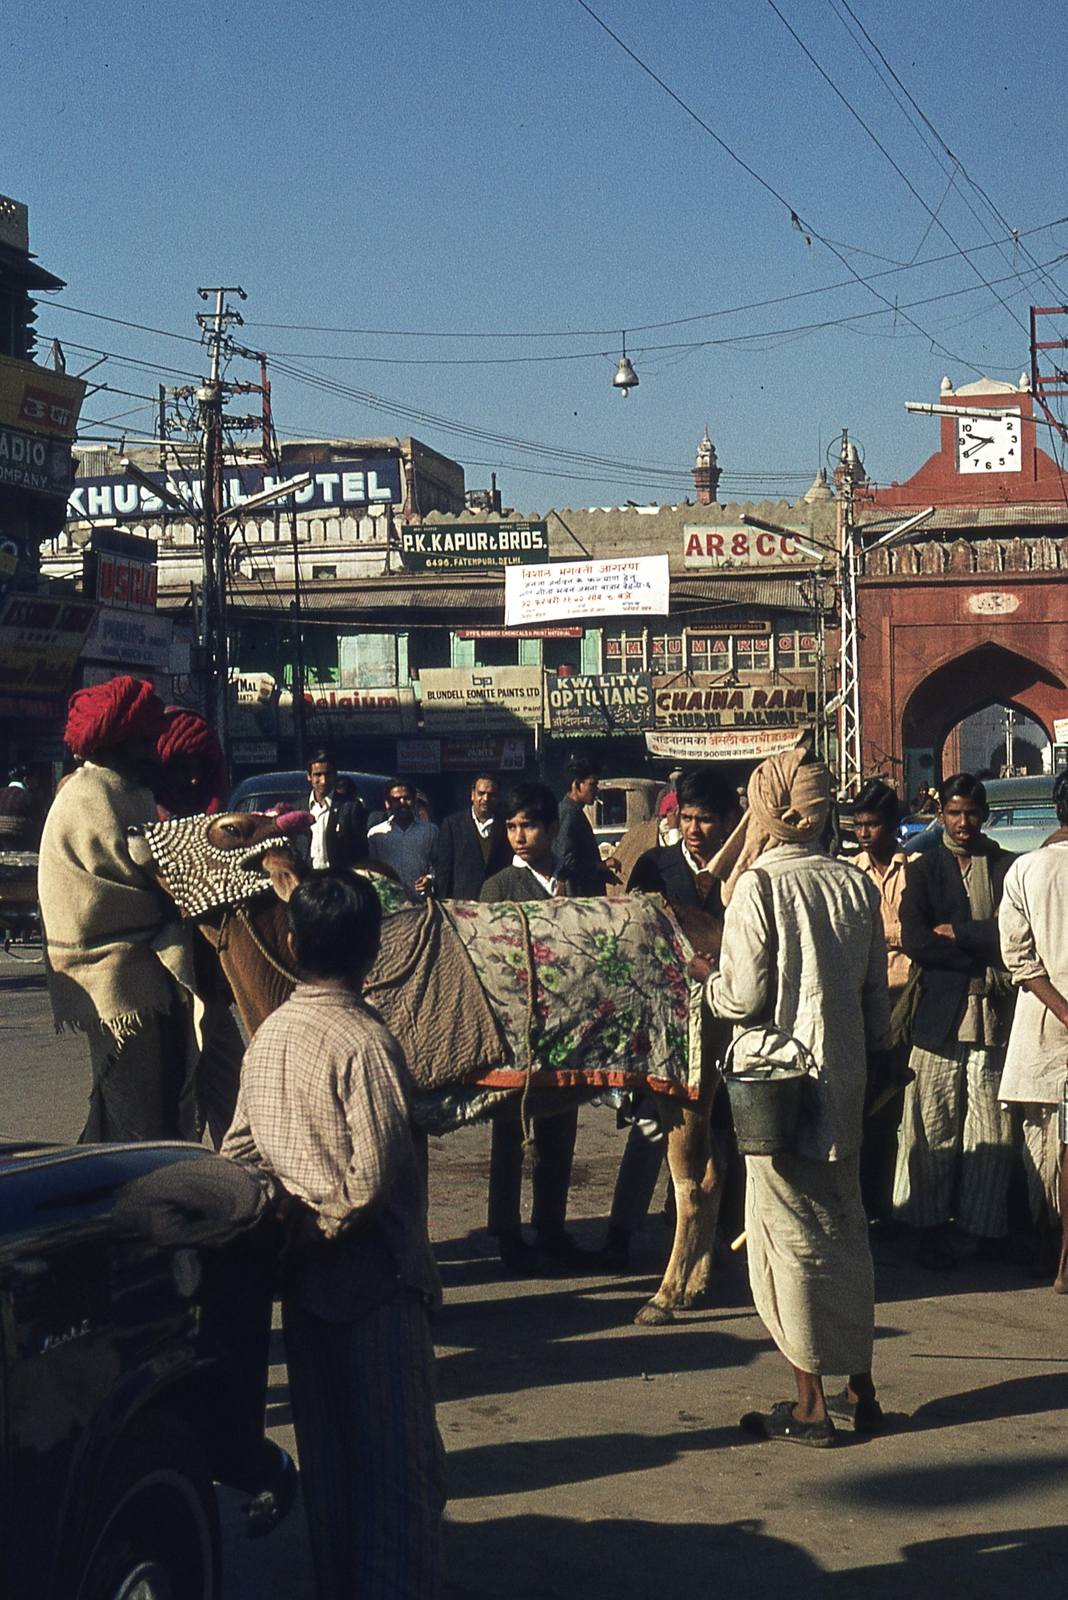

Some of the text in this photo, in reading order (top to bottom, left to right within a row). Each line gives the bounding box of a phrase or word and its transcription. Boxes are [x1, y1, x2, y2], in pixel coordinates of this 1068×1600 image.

[962, 424, 972, 432] 10
[1006, 422, 1013, 431] 2
[959, 437, 965, 445] 9
[1011, 435, 1017, 443] 3
[1008, 448, 1014, 456] 4
[973, 459, 979, 467] 7
[985, 461, 992, 469] 6
[999, 457, 1005, 466] 5
[498, 531, 548, 550] BROS.
[685, 533, 724, 557] AR
[731, 532, 750, 556] &
[522, 562, 641, 579] विशाल भगवती जागरण
[101, 562, 156, 606] USHA
[652, 639, 751, 653] KUMAR
[427, 687, 540, 700] BLUNDELL EOMITE PAINTS LTD
[550, 686, 649, 708] OPTICIANS
[656, 689, 806, 711] CHAINA RAM
[668, 712, 722, 727] SINDHI
[709, 734, 738, 746] असली
[738, 732, 769, 744] कराची
